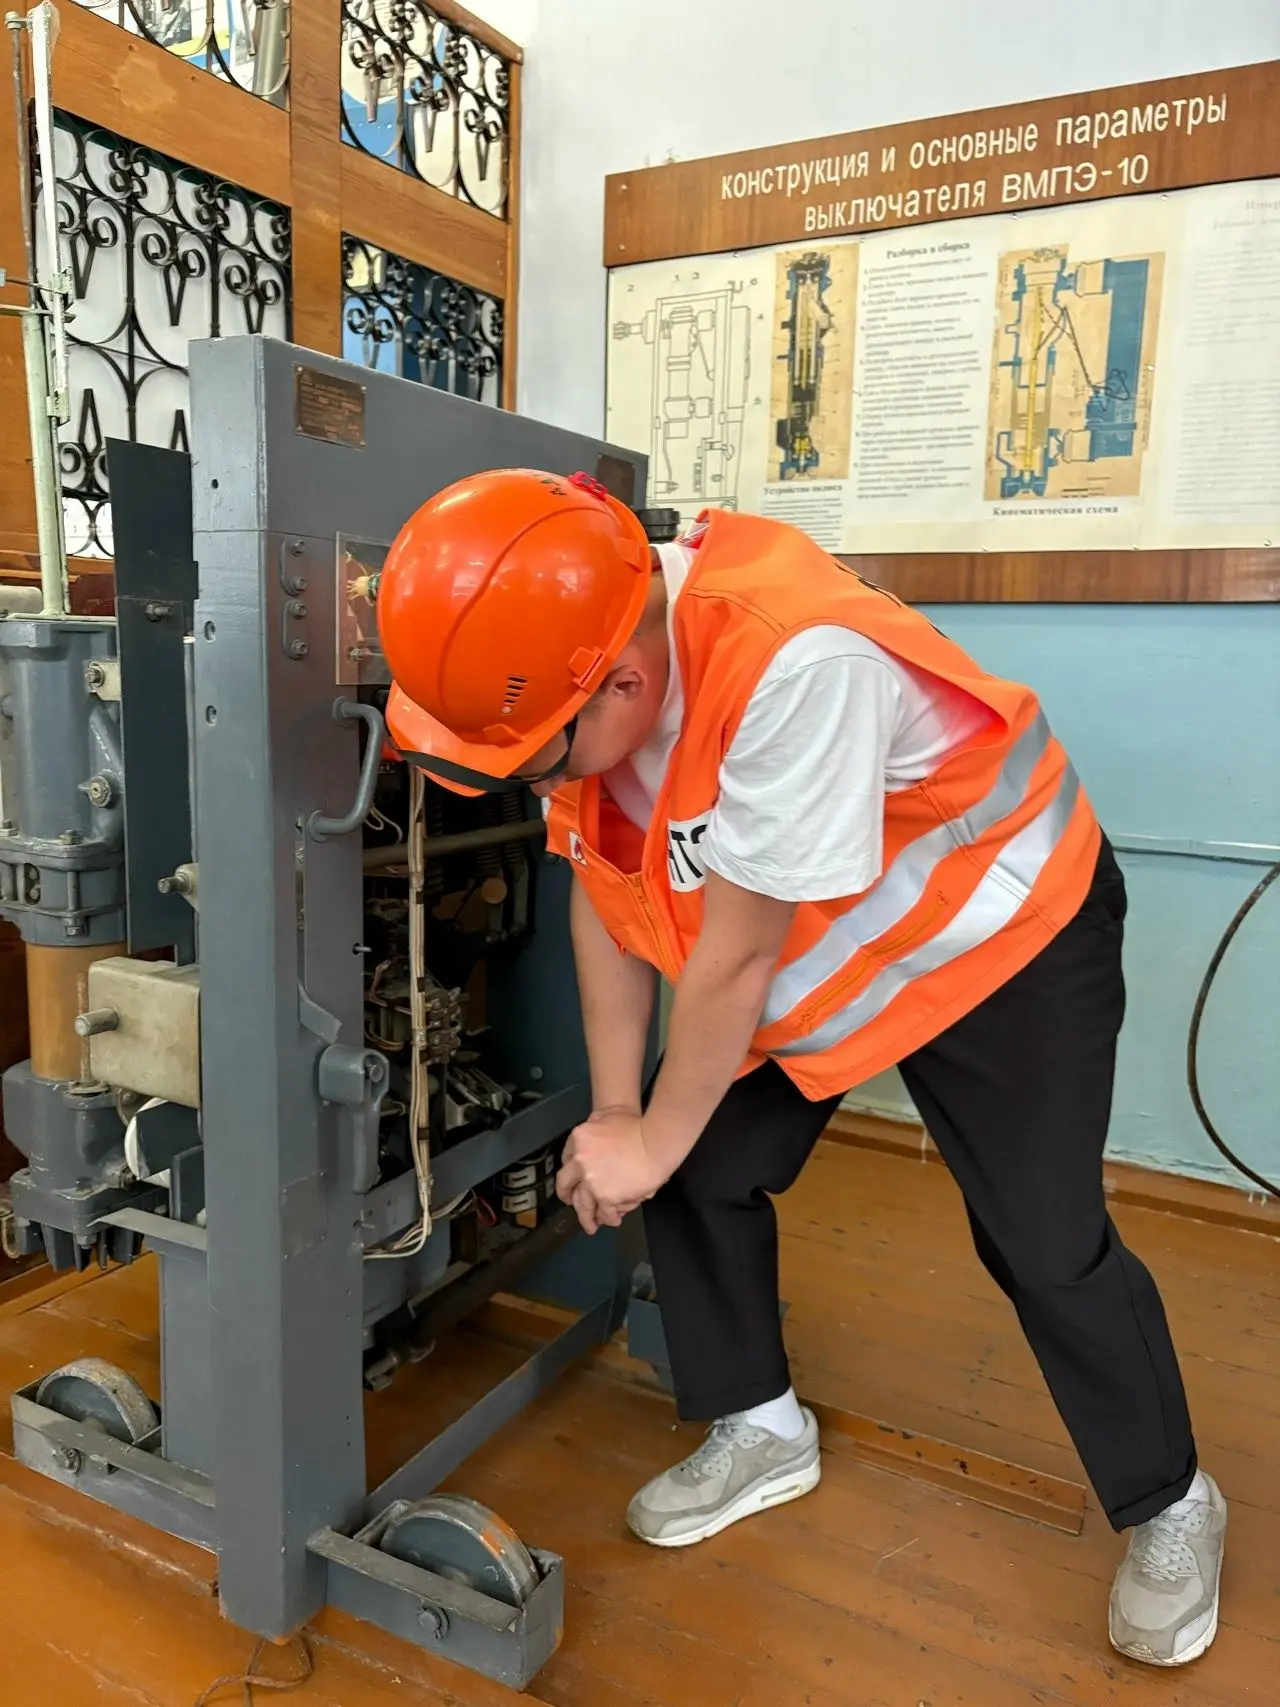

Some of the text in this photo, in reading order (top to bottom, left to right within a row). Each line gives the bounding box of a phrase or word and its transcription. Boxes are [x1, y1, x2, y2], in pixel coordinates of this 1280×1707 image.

[721, 93, 1227, 199] конструкция и основные параметры
[804, 154, 1149, 232] выключателя ВМПЭ-10
